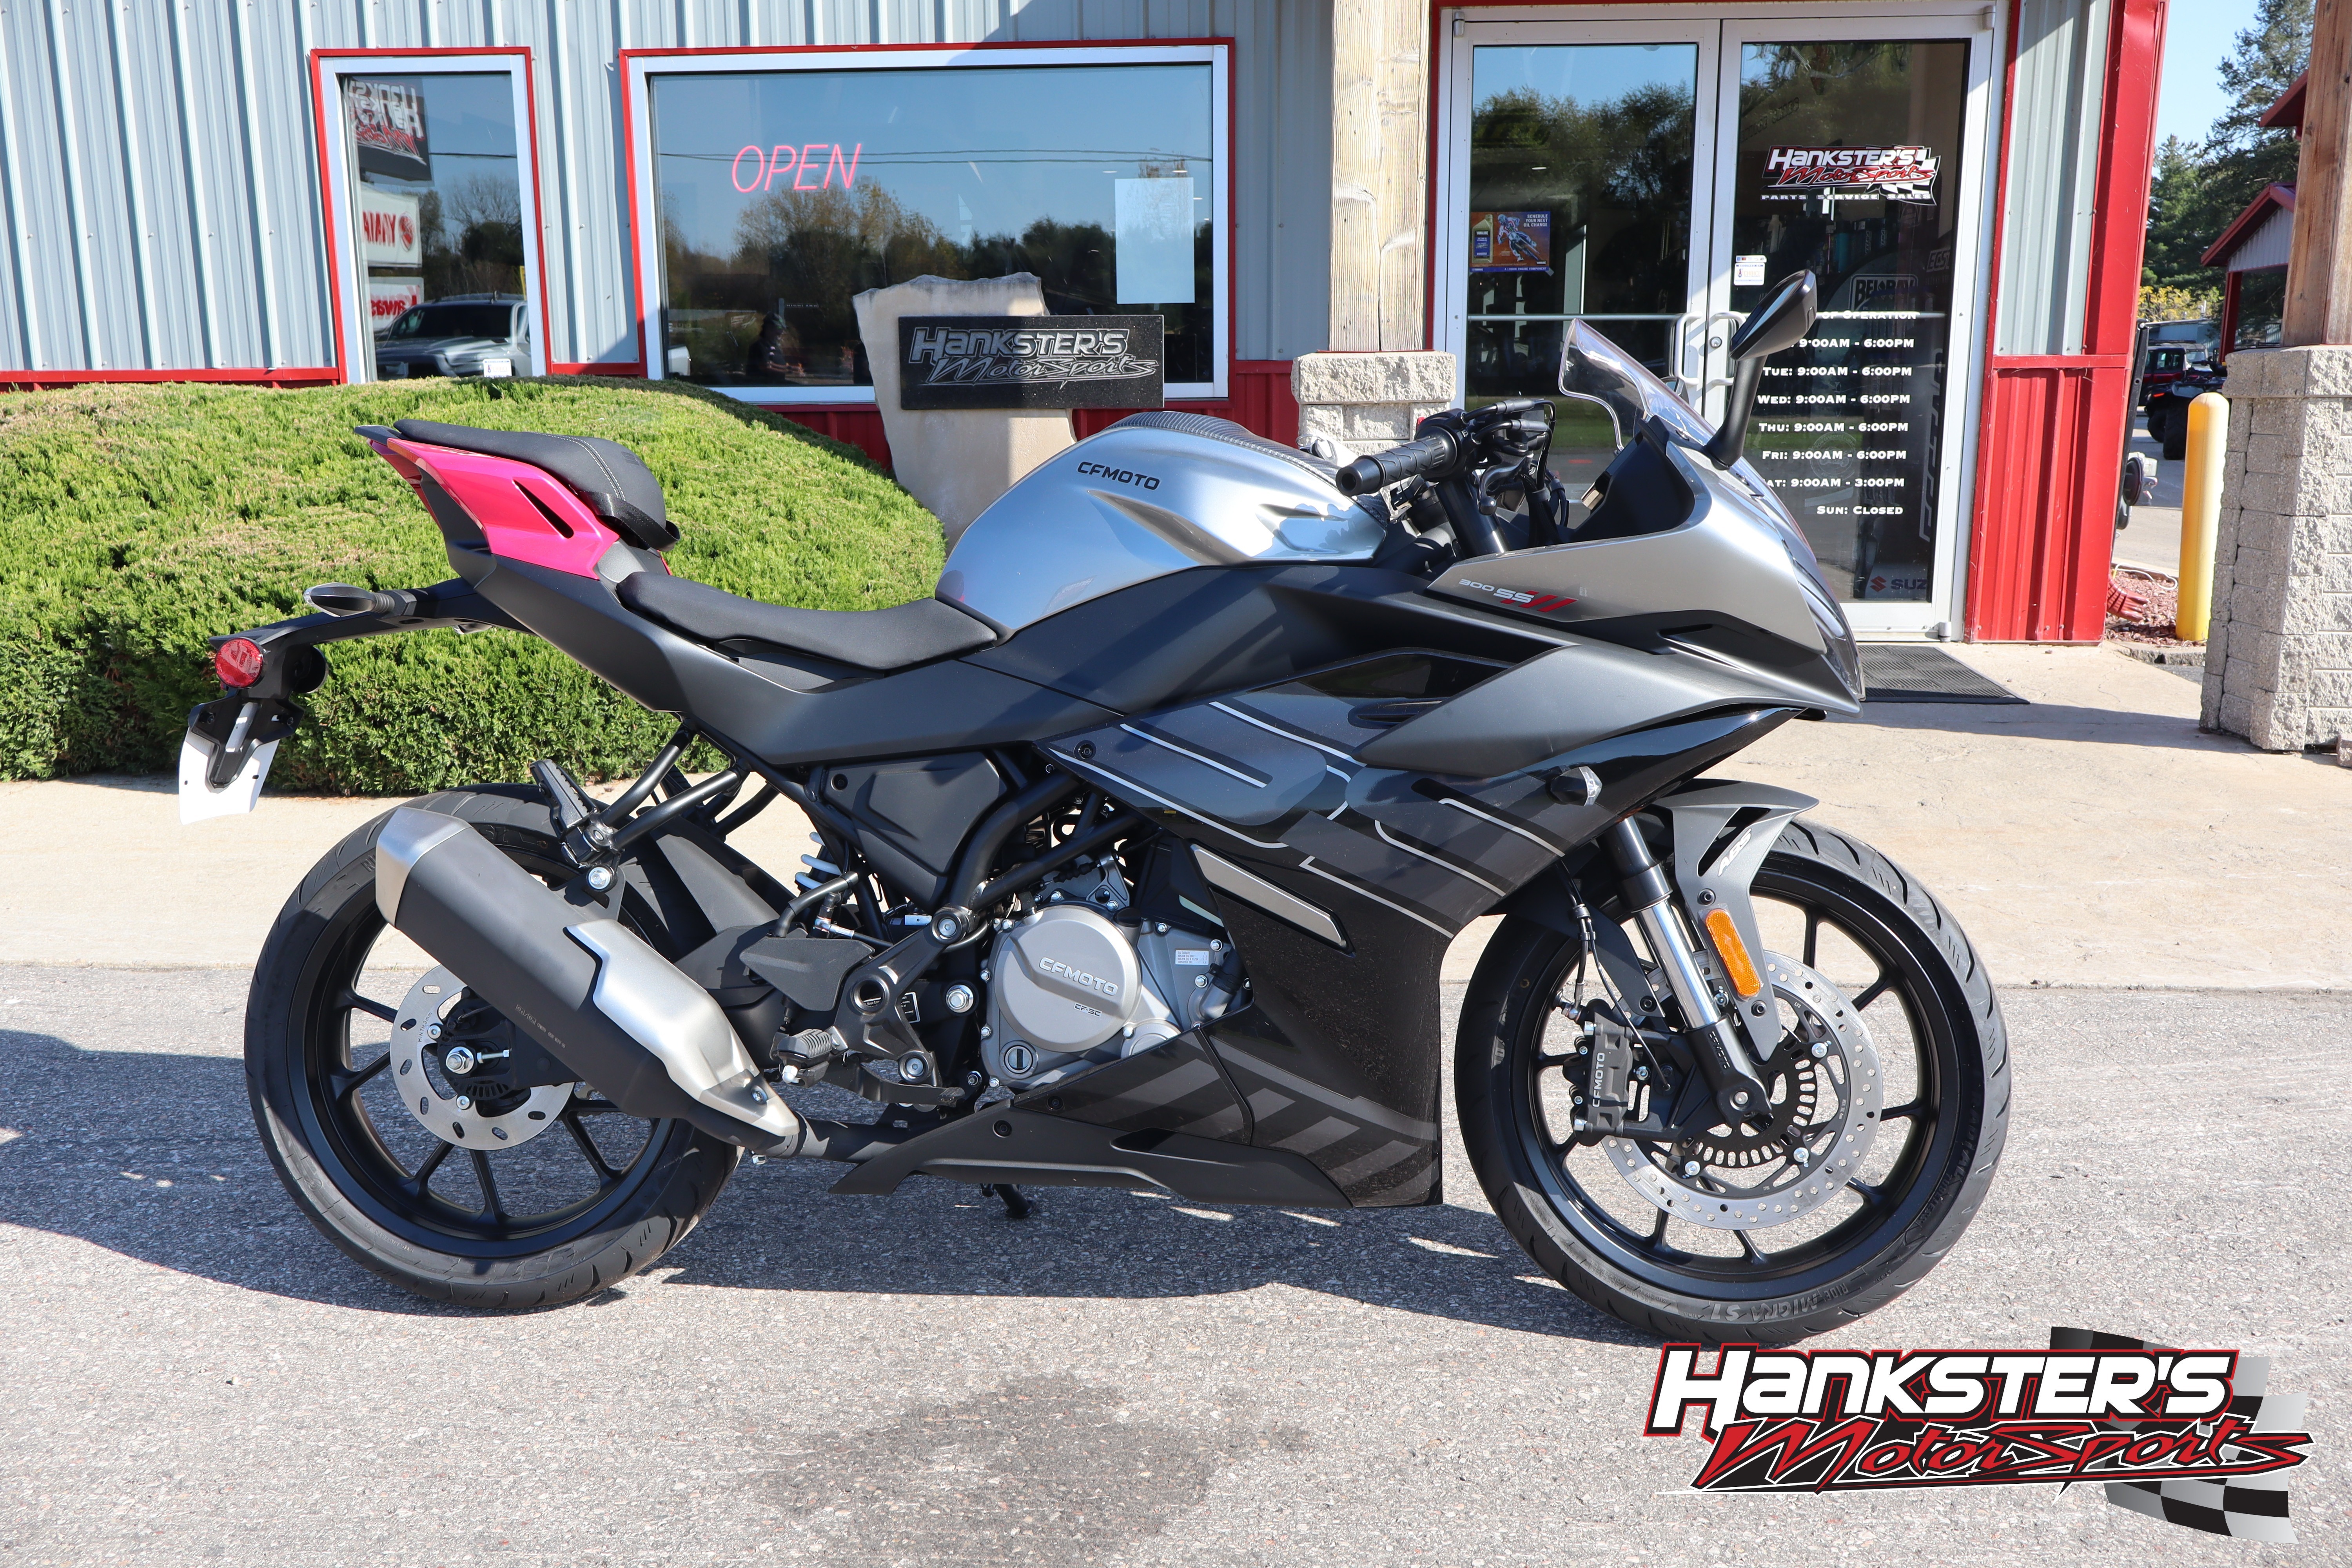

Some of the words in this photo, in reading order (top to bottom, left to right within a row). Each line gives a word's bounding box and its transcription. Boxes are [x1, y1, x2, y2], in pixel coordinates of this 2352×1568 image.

[732, 143, 861, 192] OPEN
[1842, 310, 1916, 319] OPERATION
[1864, 339, 1914, 347] 6:00PM
[1798, 367, 1847, 376] 9:00AM
[1862, 367, 1911, 376] 6:00PM
[1796, 395, 1846, 403] 9:00AM
[1860, 395, 1910, 403] 6:00PM
[1795, 423, 1844, 431] 9:00AM
[1858, 423, 1908, 431] 6:00PM
[1793, 451, 1842, 459] 9:00AM
[1857, 451, 1906, 459] 6:00PM
[1078, 461, 1160, 490] CFMOTO
[1764, 479, 1786, 487] AT:
[1791, 478, 1840, 487] 9:00AM
[1853, 506, 1903, 514] CLOSED
[1459, 579, 1495, 592] 300
[1493, 588, 1534, 603] SS
[1718, 828, 1751, 877] ABS
[1040, 957, 1118, 996] CFMOTO
[1075, 1004, 1101, 1016] CF-SC
[1592, 1052, 1605, 1108] CFMOTO
[1824, 1283, 1849, 1302] RIDE
[1749, 1291, 1821, 1322] MIGRA
